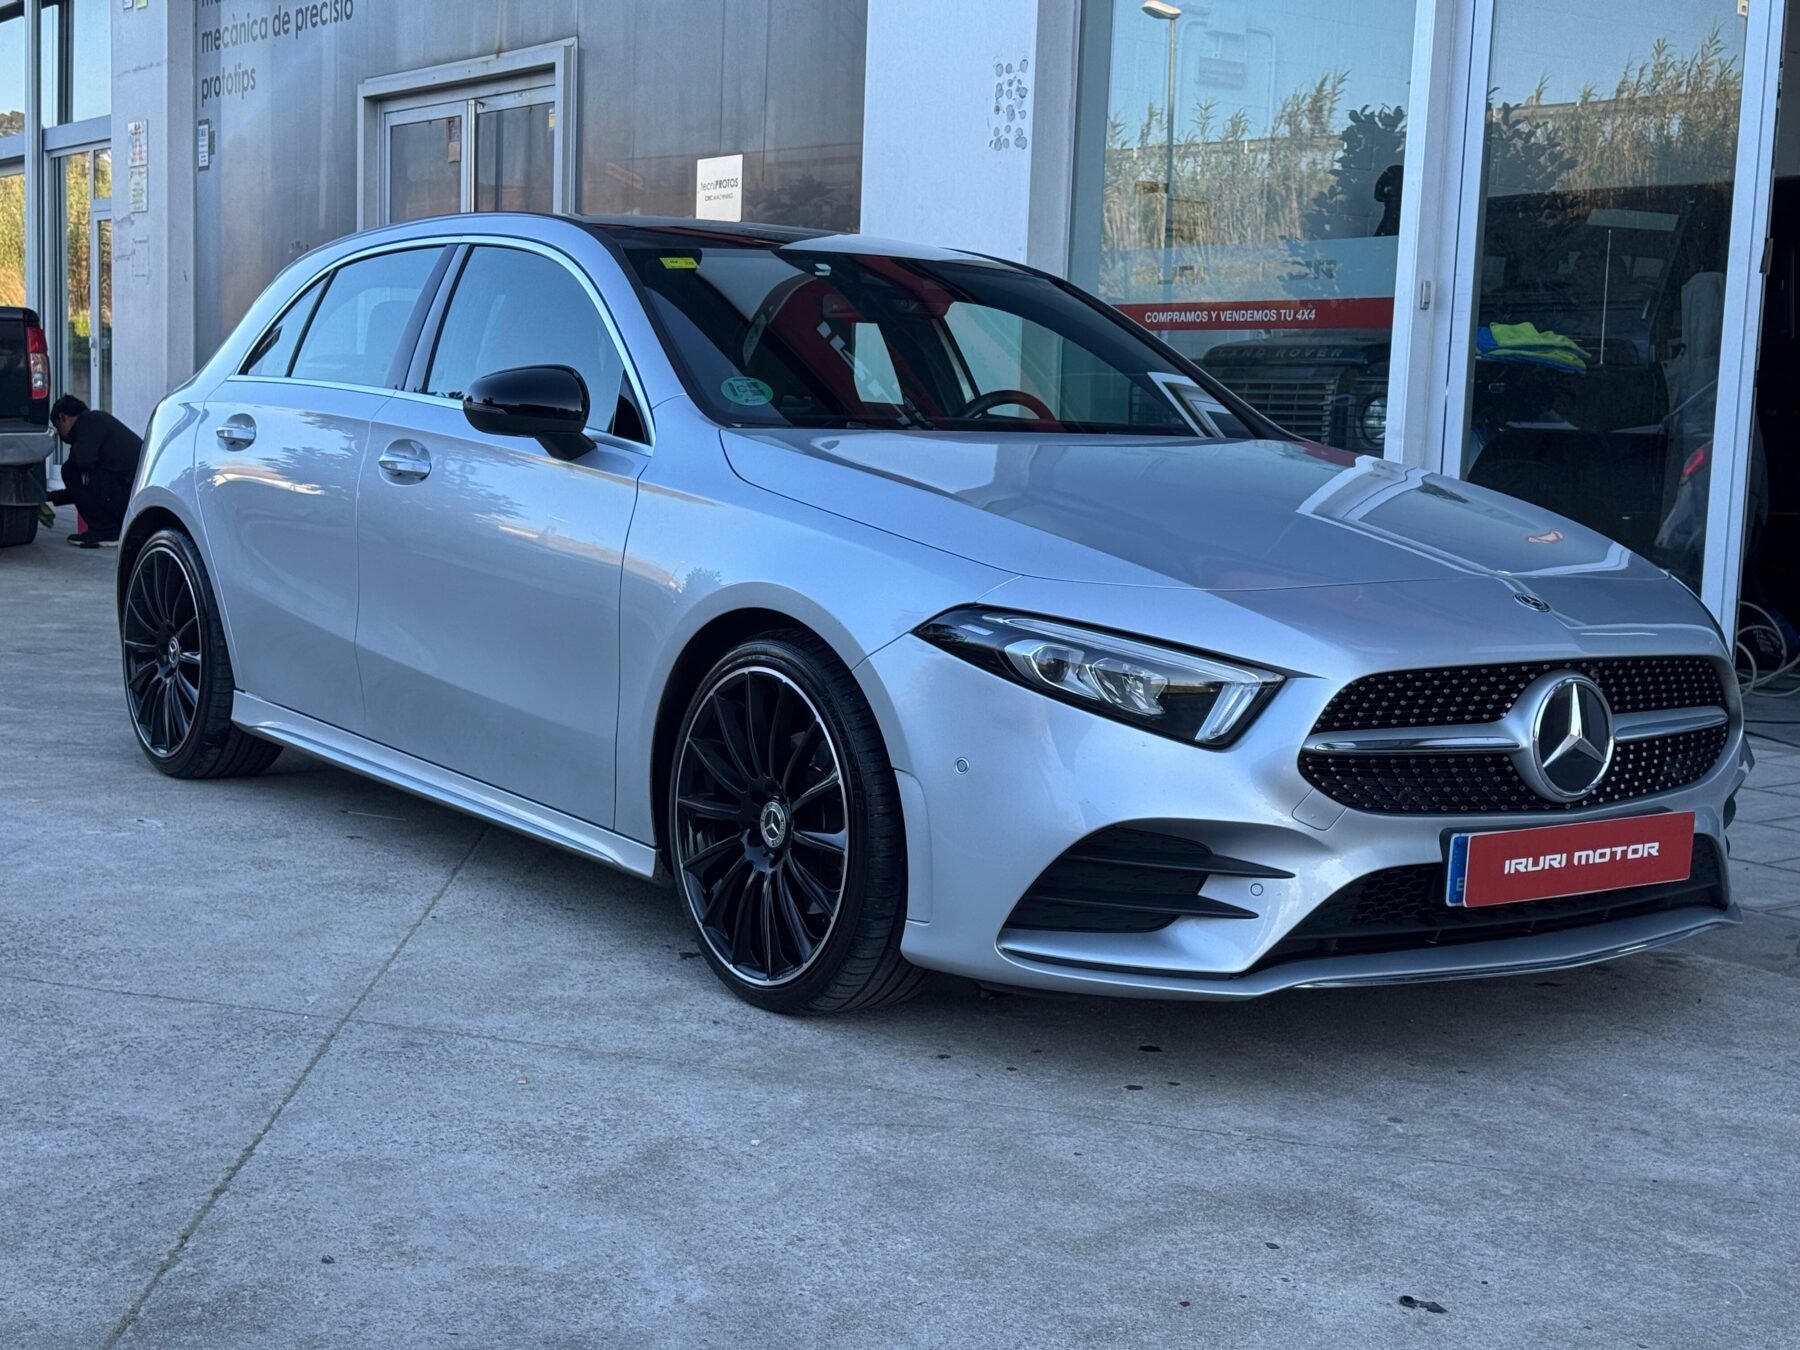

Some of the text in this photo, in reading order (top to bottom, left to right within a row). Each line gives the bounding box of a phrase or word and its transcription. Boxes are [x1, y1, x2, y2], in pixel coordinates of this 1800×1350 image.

[202, 12, 268, 53] mecànica
[272, 5, 291, 37] de
[201, 63, 256, 107] prototips
[1145, 308, 1316, 323] COMPRAMOS Y VENDEMOS TU 4X4
[1275, 346, 1344, 358] ROVER
[1504, 842, 1660, 875] IRURI MOTOR
